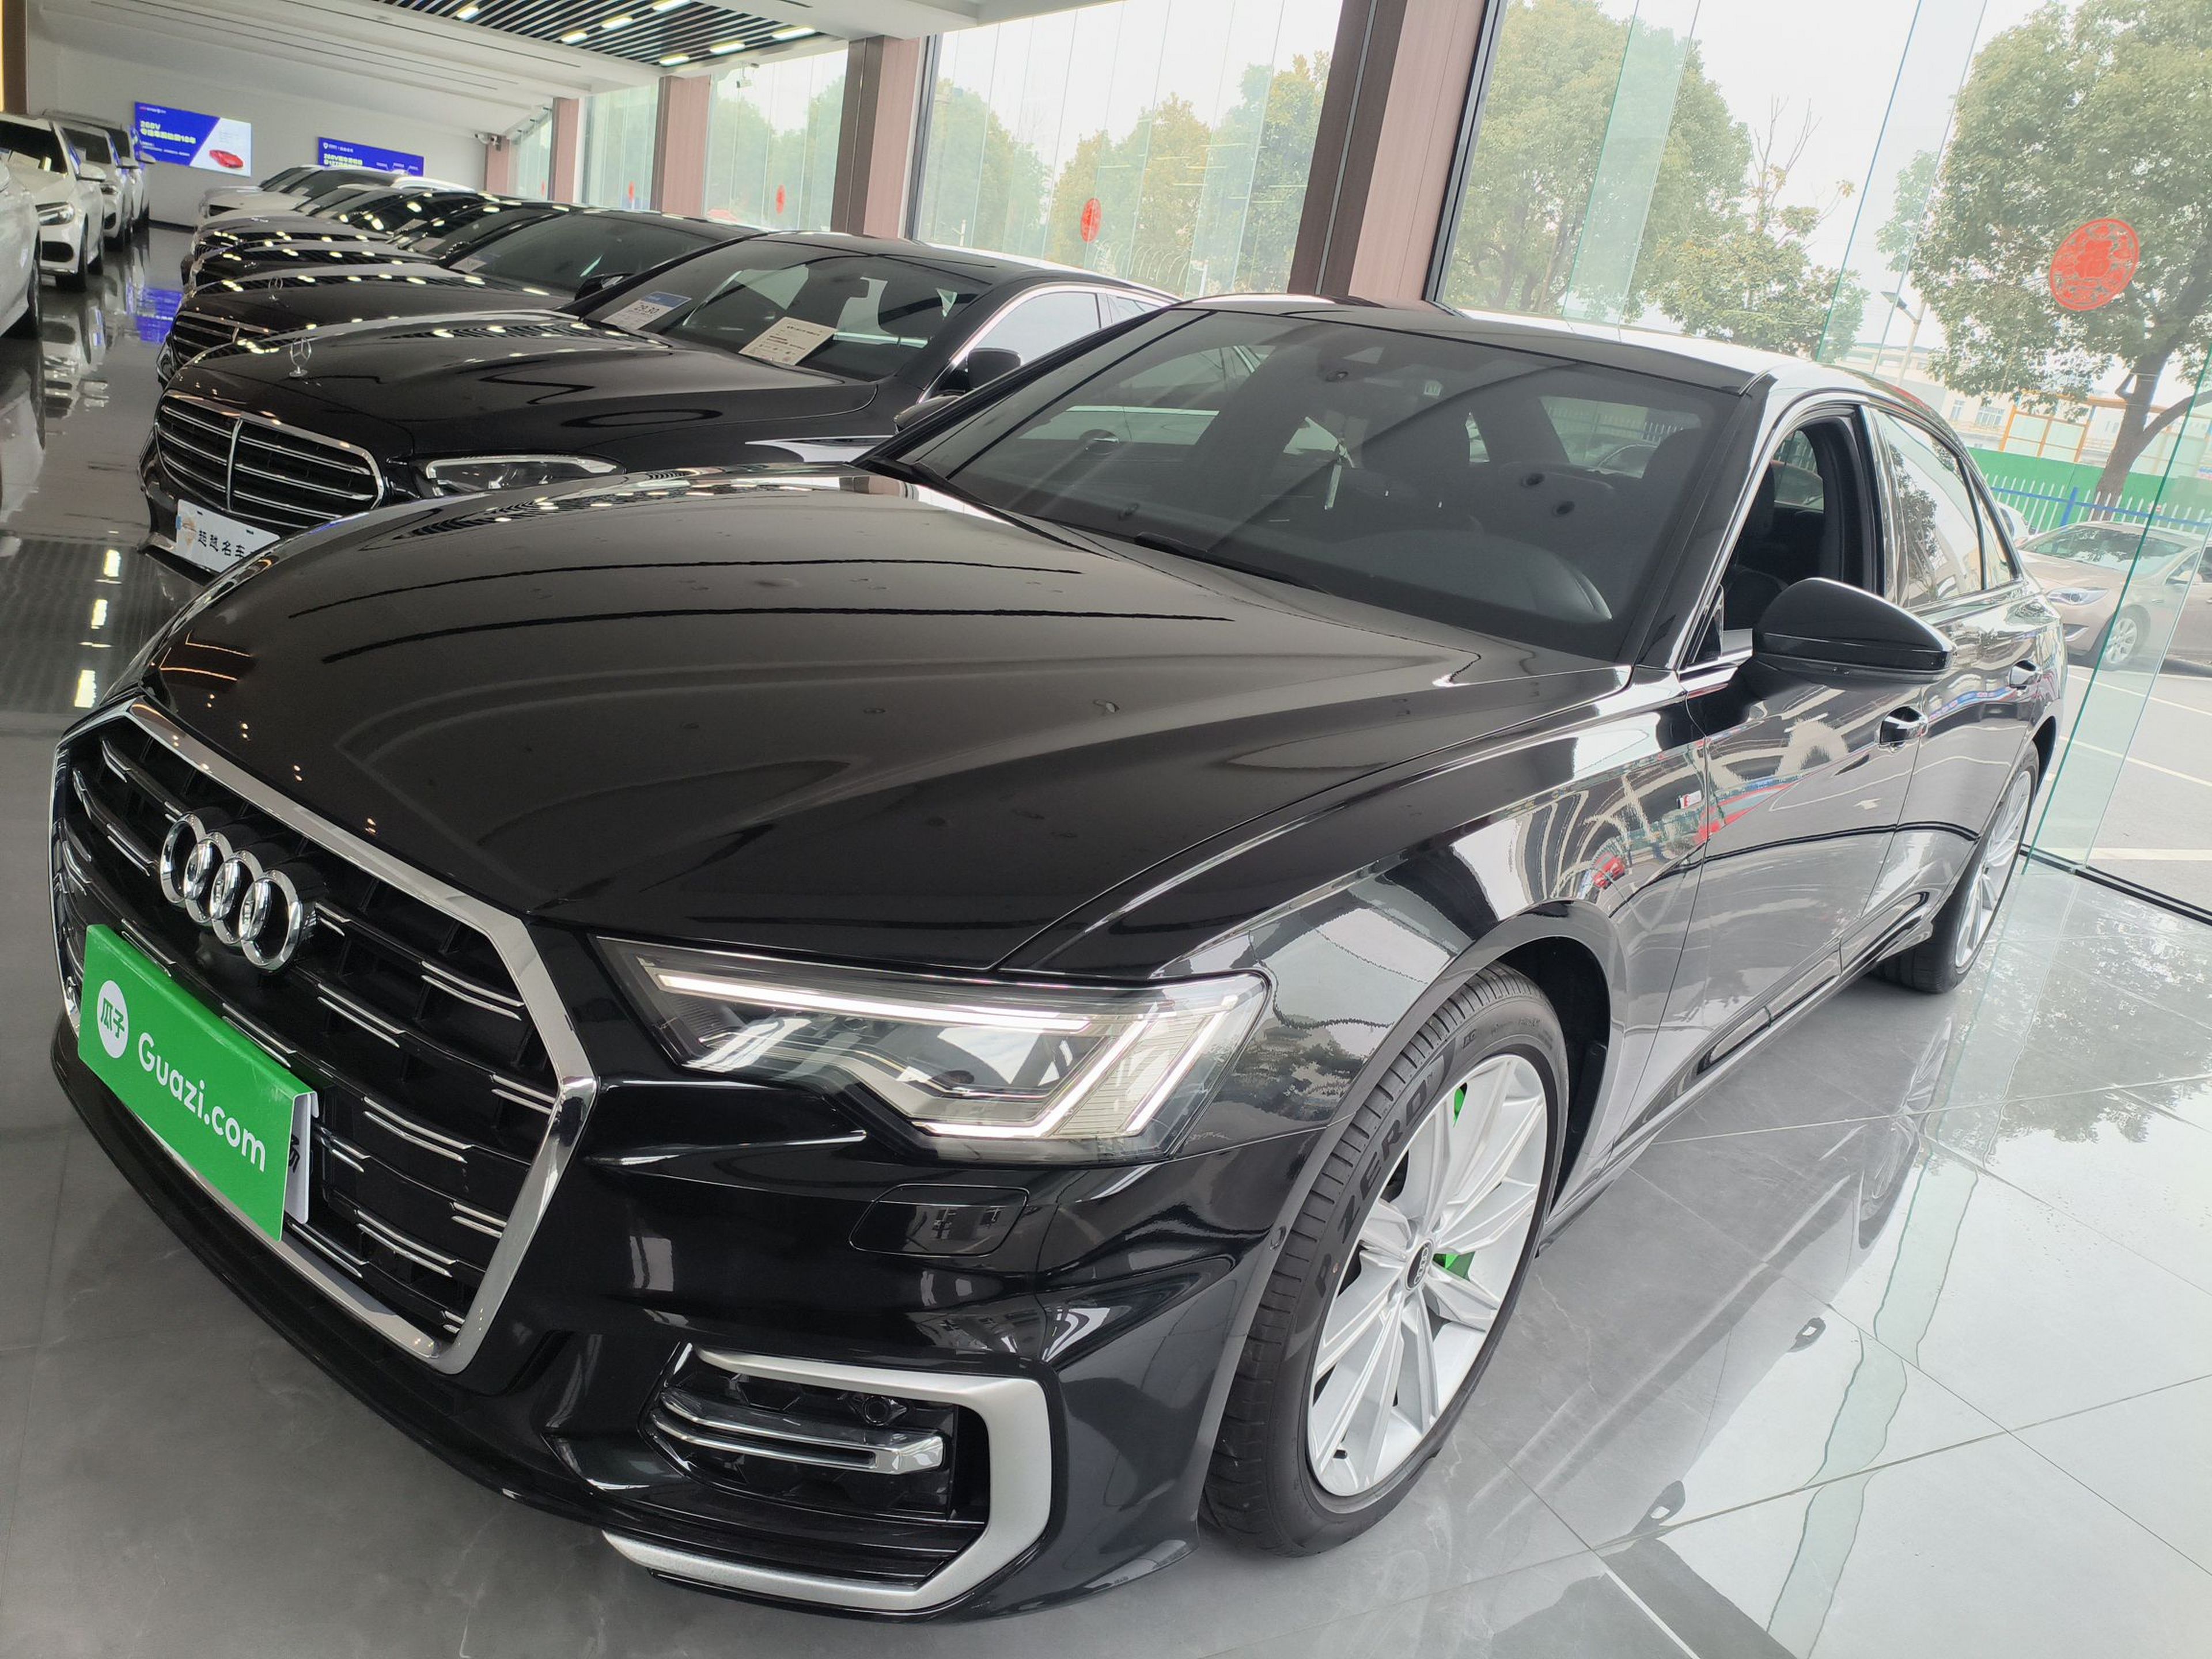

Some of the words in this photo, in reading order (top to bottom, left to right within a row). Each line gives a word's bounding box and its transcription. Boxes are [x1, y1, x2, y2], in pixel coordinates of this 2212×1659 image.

[100, 997, 125, 1038] 瓜子
[138, 1032, 266, 1173] Guazi.com
[1337, 1079, 1427, 1244] ZERO
